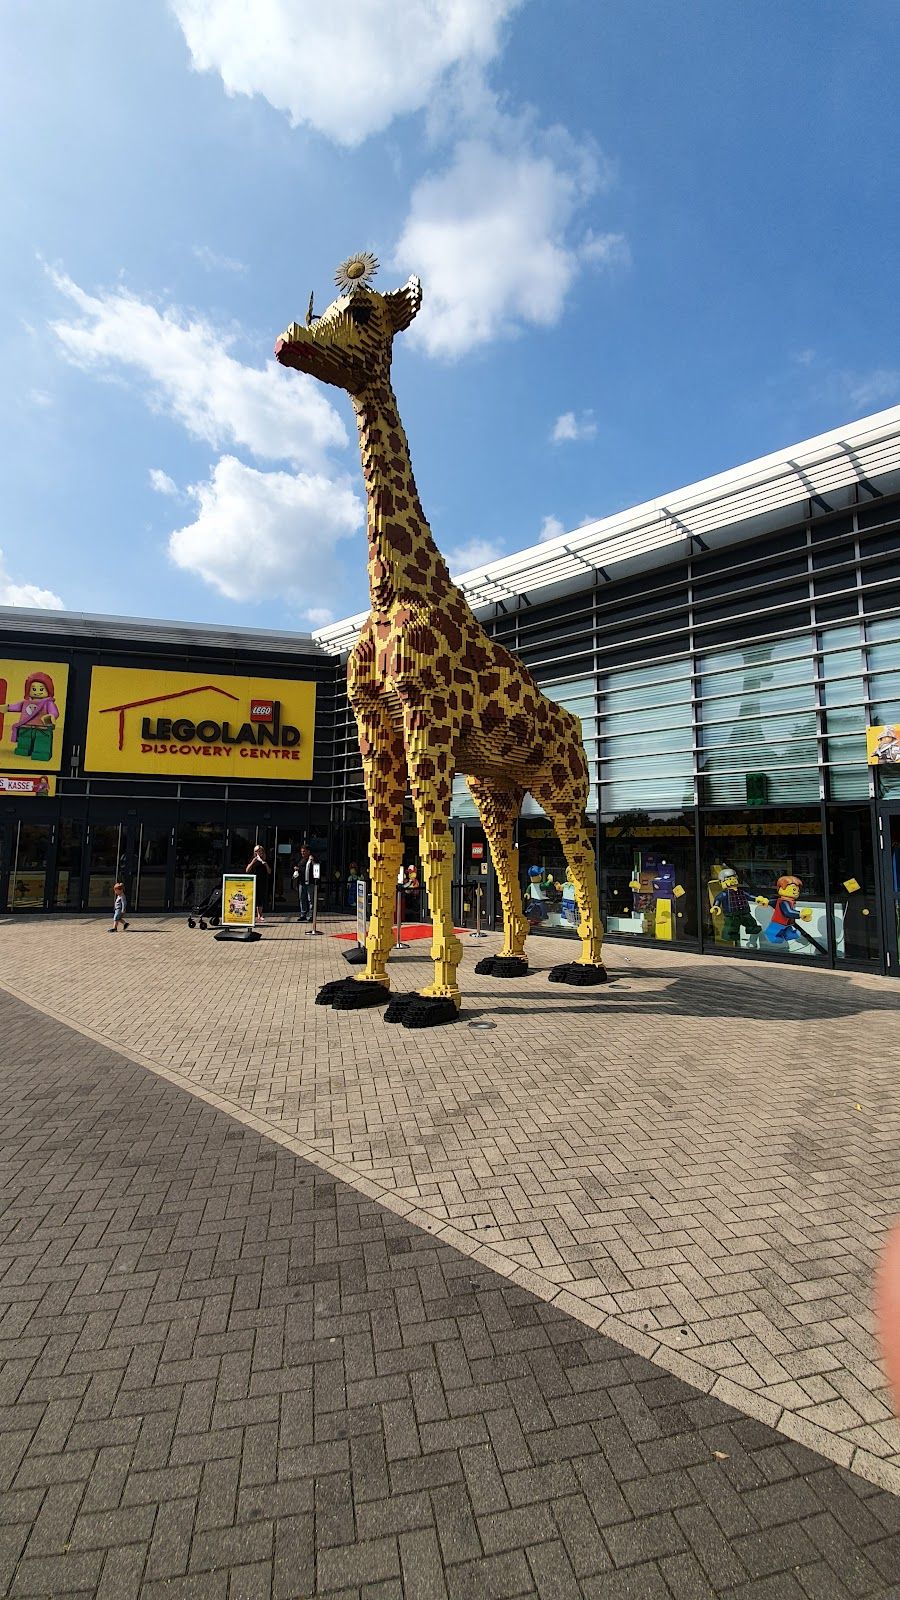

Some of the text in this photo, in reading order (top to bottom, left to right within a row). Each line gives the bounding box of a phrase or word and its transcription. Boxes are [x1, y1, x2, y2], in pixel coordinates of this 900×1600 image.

[252, 706, 271, 714] LEGO
[141, 701, 300, 747] LEGOLAND
[141, 744, 300, 760] DISCOVERY CENTRE
[8, 781, 30, 790] KASSE
